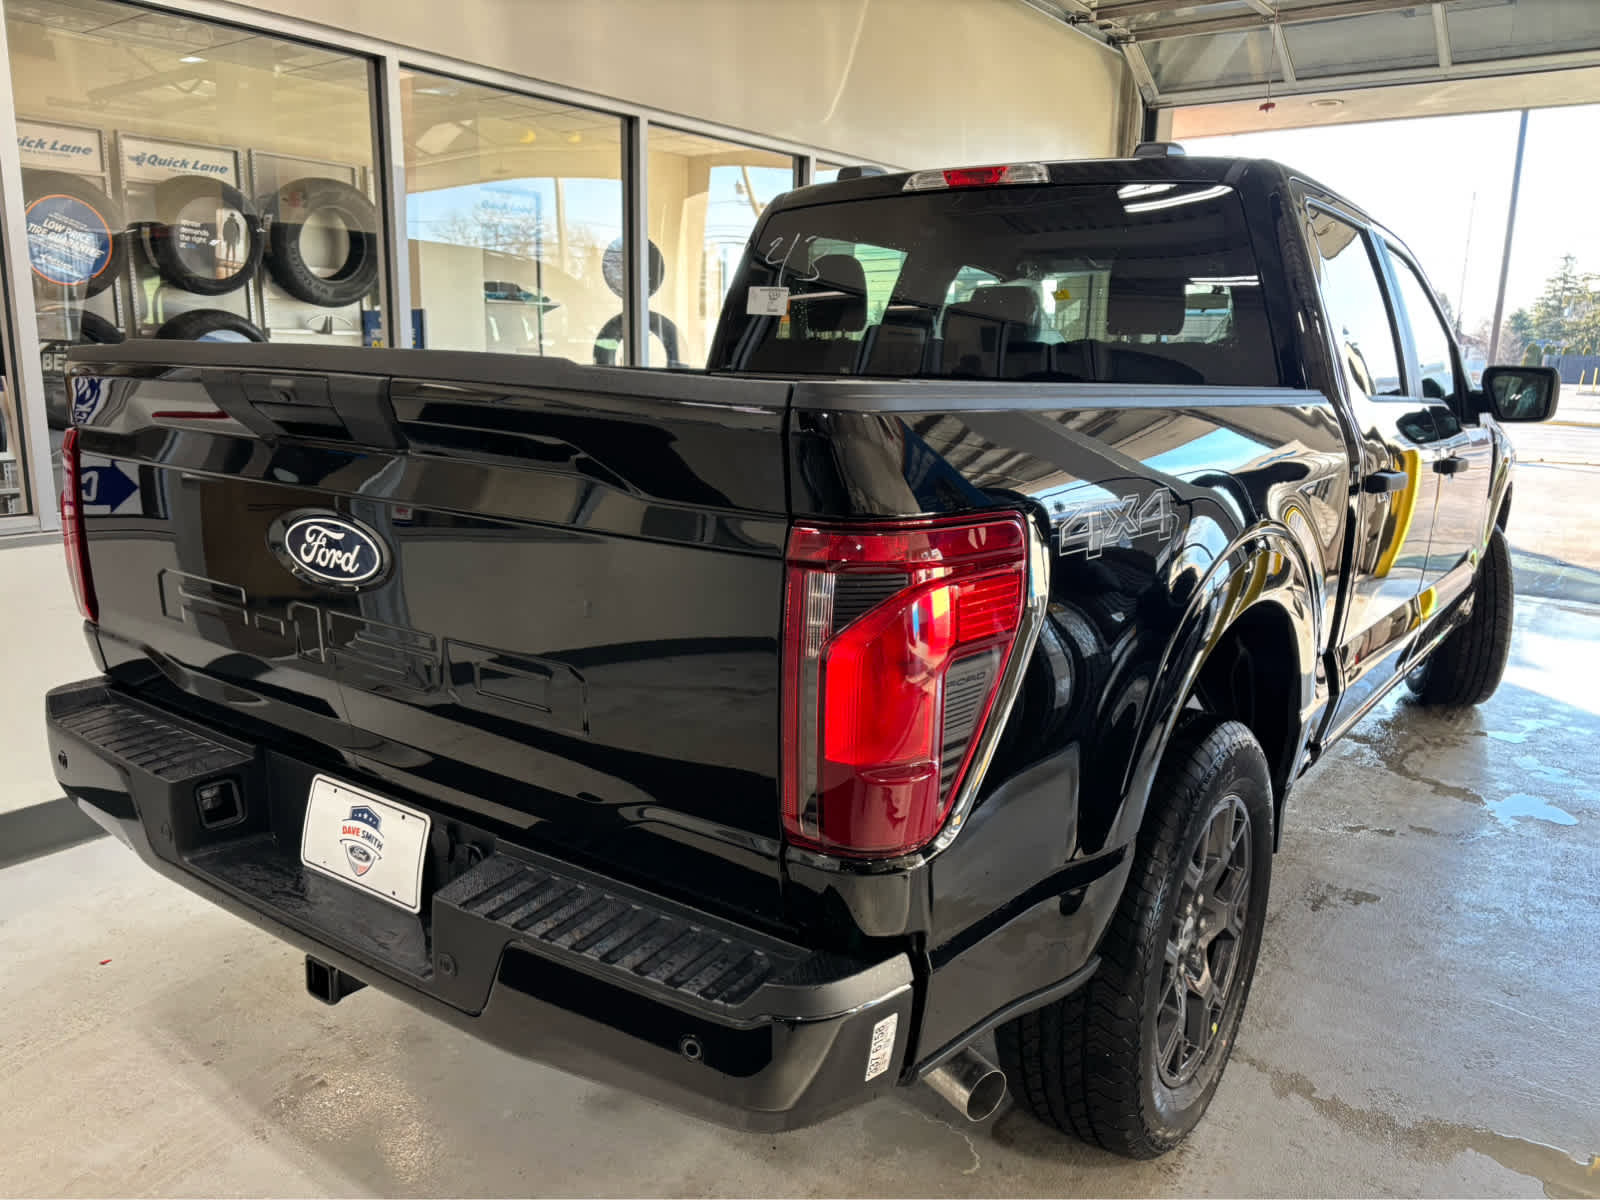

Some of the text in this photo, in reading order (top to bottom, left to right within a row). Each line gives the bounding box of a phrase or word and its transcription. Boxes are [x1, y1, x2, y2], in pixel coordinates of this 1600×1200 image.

[17, 136, 46, 149] uick
[50, 140, 93, 155] Lane
[147, 154, 189, 168] Quick
[192, 160, 228, 174] Lane
[28, 223, 49, 234] TIRE
[43, 218, 66, 233] LOW
[300, 525, 361, 573] Ford
[342, 825, 384, 851] DAVE SMITH
